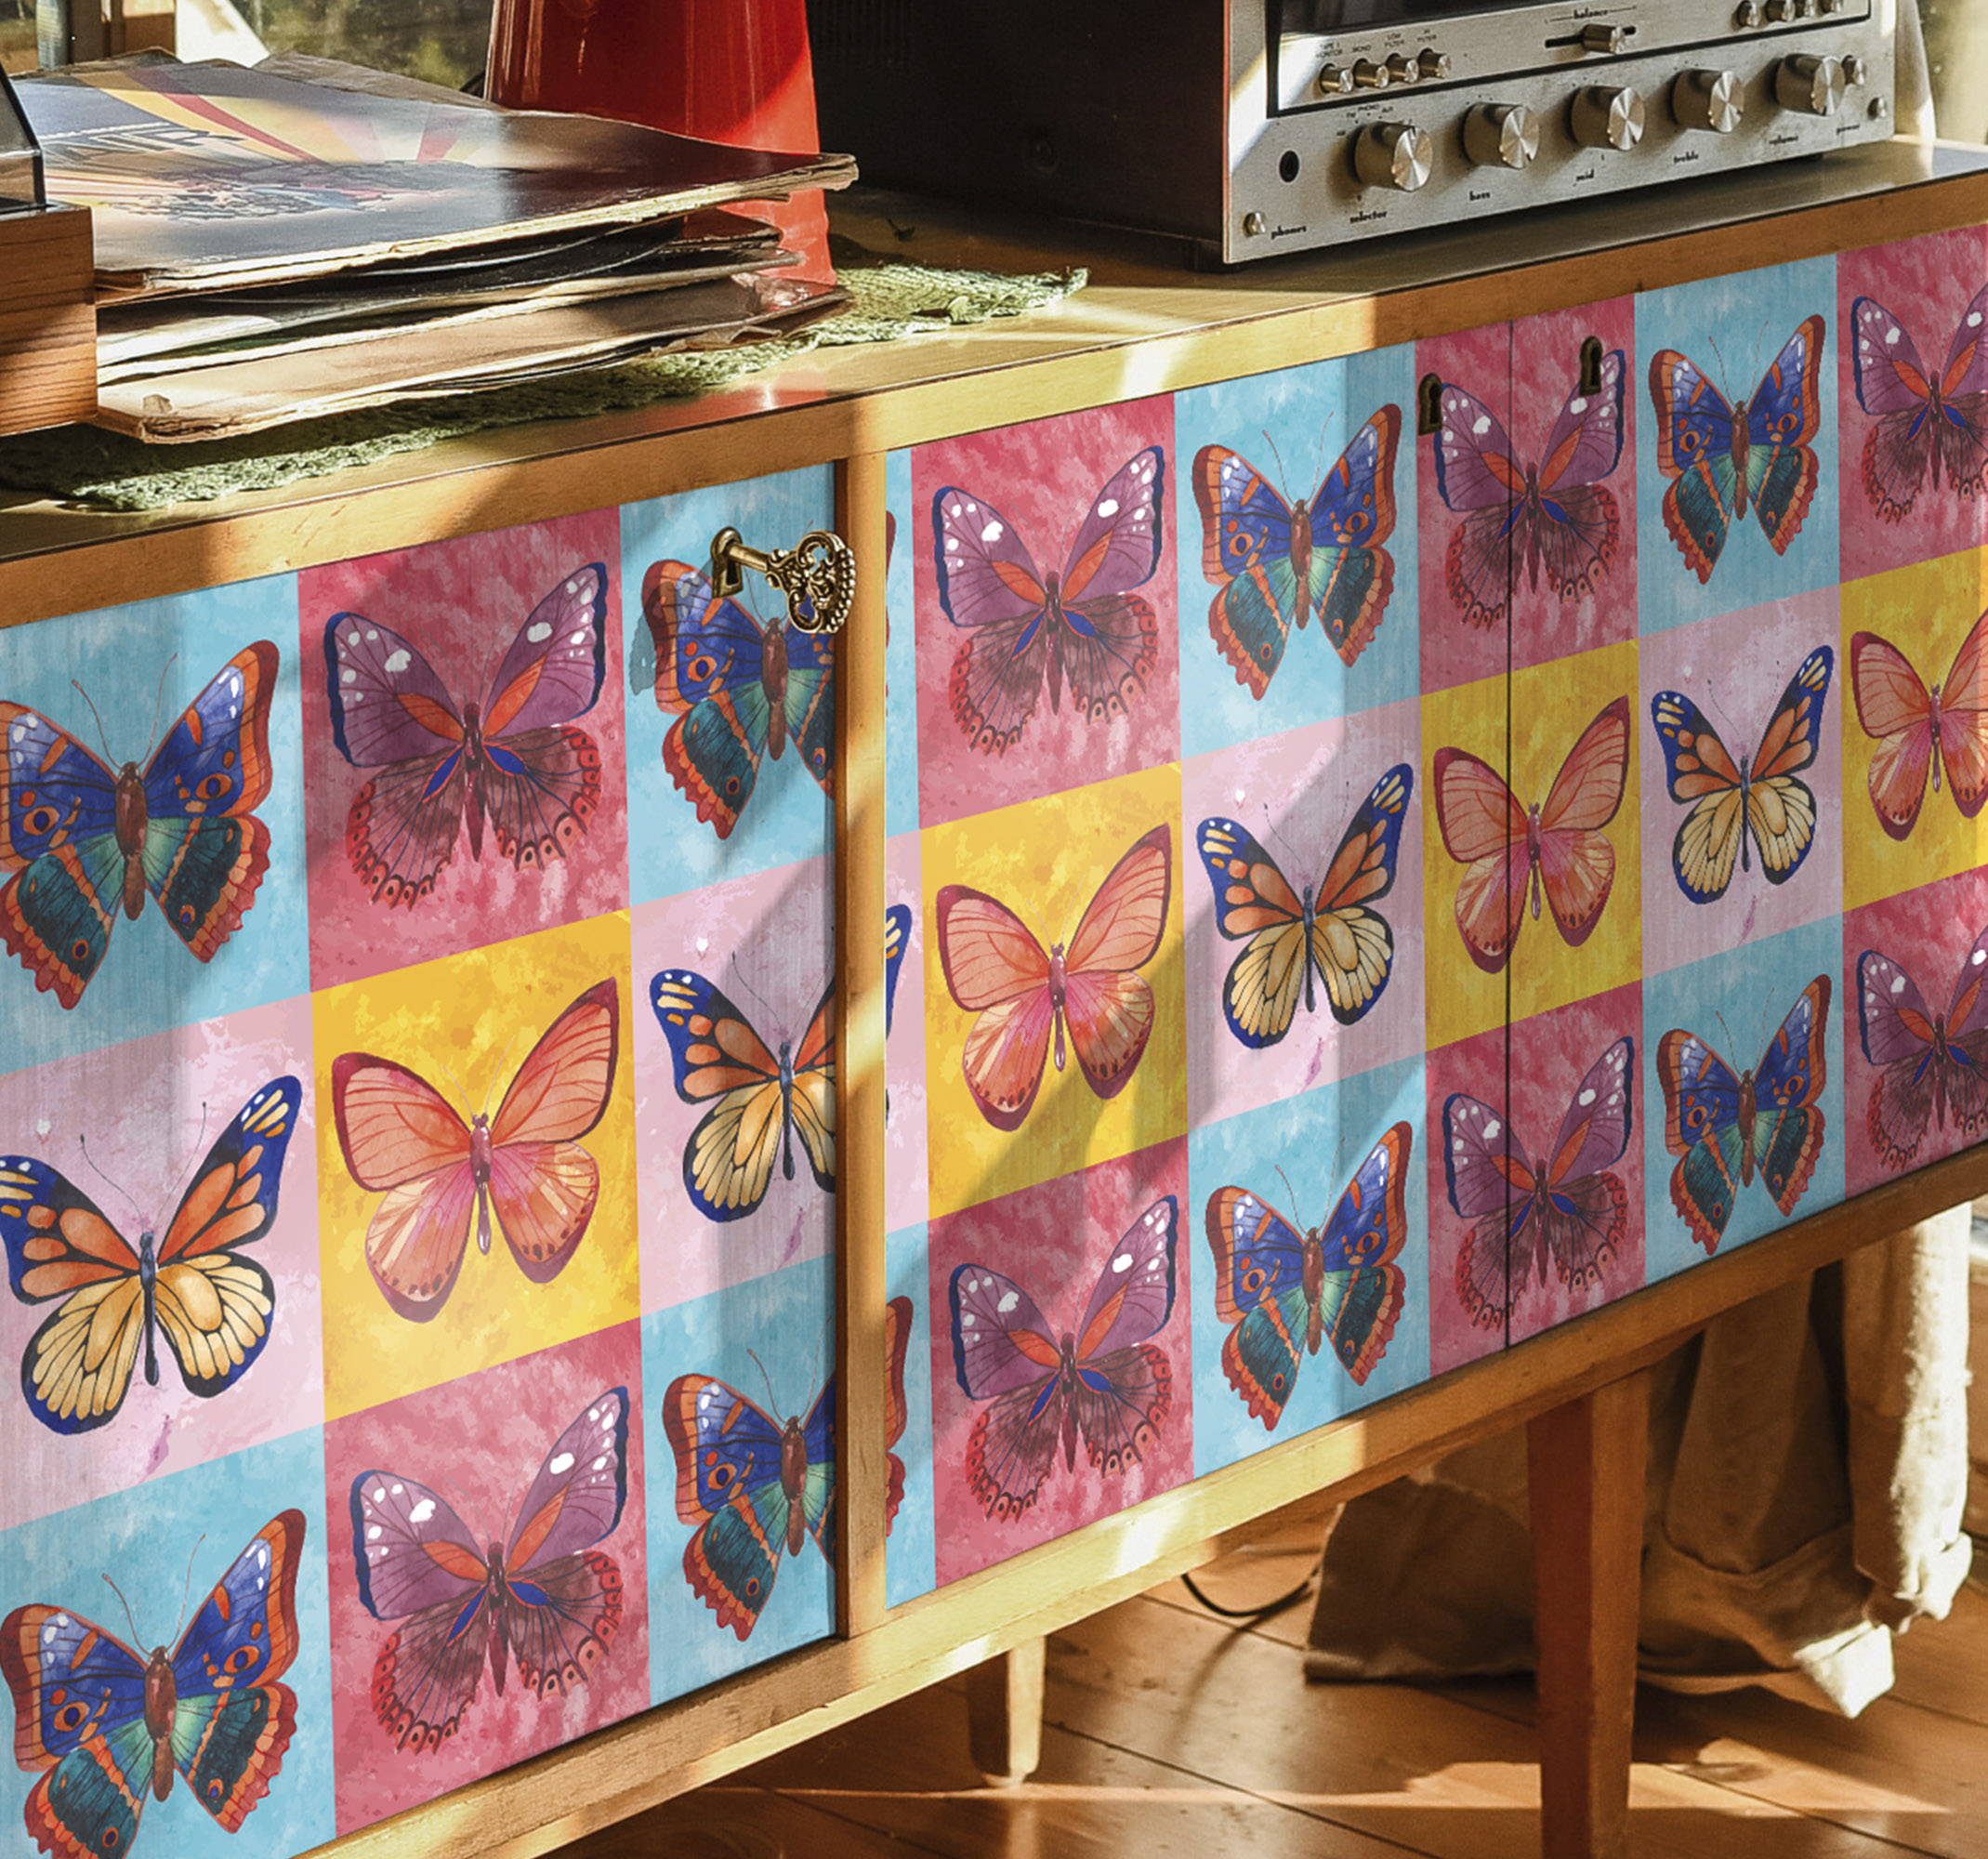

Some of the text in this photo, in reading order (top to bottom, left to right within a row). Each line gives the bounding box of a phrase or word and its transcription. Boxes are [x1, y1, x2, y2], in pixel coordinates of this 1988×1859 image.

[1573, 7, 1609, 20] balance
[1673, 150, 1699, 164] treble
[1575, 168, 1595, 182] mid
[1469, 190, 1491, 202] bass
[1349, 209, 1388, 224] selector
[1270, 224, 1307, 240] phones
